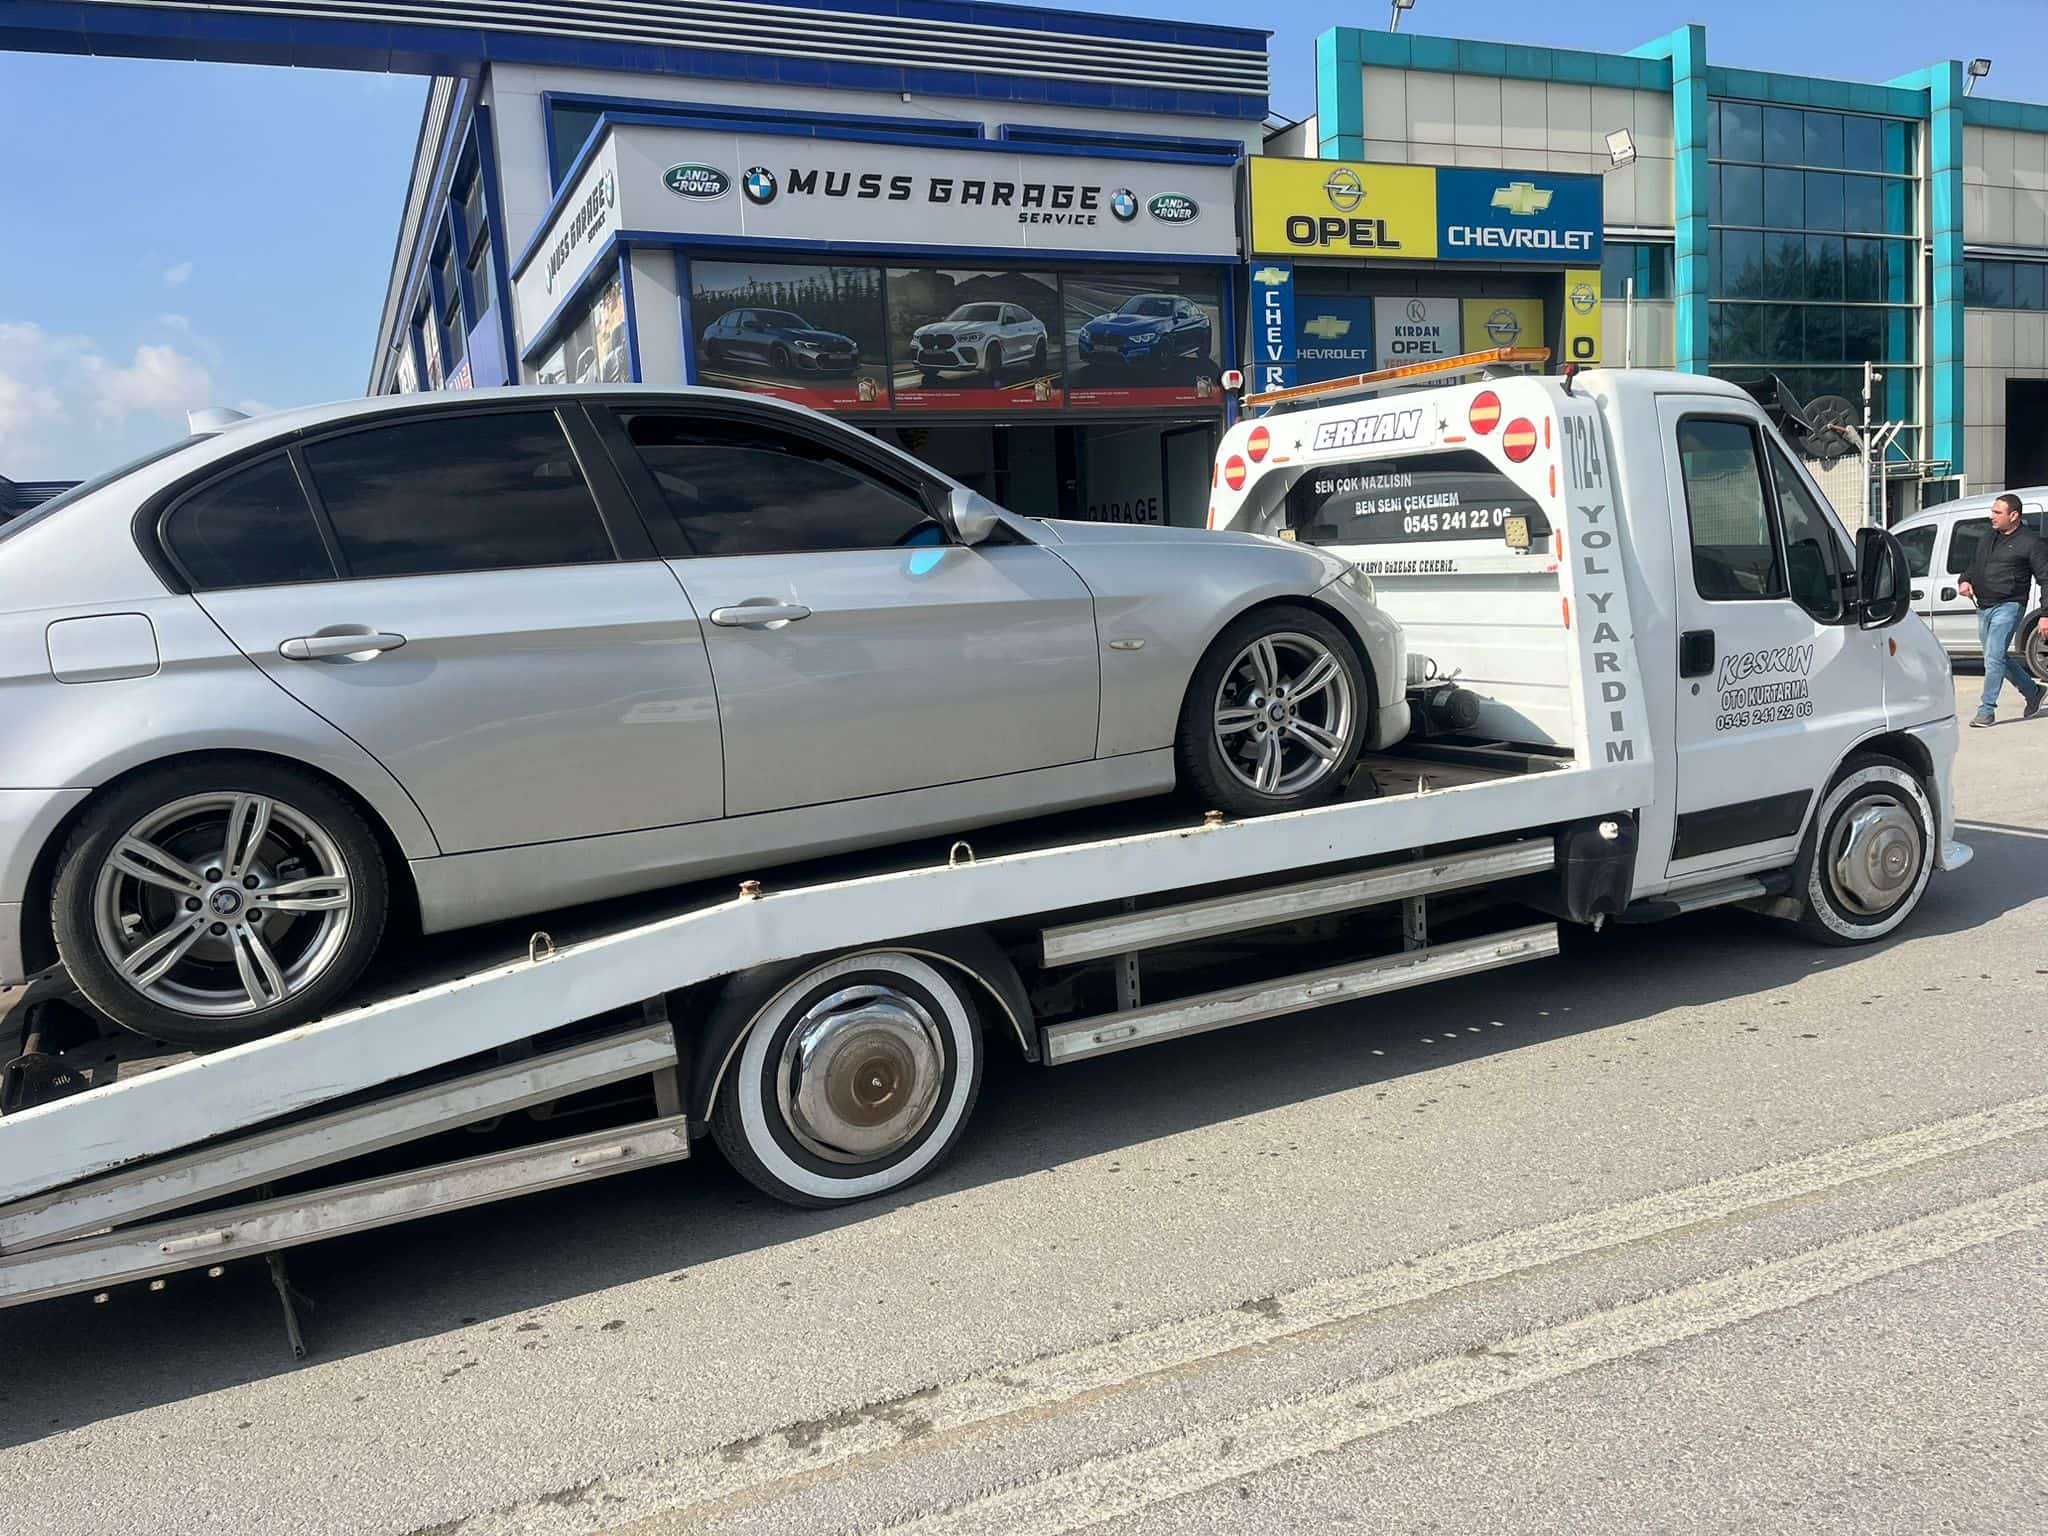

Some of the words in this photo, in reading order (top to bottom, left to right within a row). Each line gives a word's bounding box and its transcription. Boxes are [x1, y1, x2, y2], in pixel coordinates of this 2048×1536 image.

[676, 170, 710, 181] LAND
[680, 180, 720, 193] ROVER
[787, 168, 912, 201] MUSS
[928, 178, 1102, 210] GARAGE
[569, 177, 605, 250] GARAGE
[1157, 198, 1183, 209] LAND
[1160, 208, 1192, 219] ROVER
[1018, 212, 1096, 226] SERVICE
[1286, 215, 1401, 250] OPEL
[1448, 226, 1594, 250] CHEVROLET
[1395, 326, 1440, 338] KIRDAN
[1297, 348, 1367, 360] HEVROLET
[1392, 341, 1443, 354] OPEL
[1313, 408, 1423, 451] ERHAN
[1315, 479, 1334, 495] SEN
[1336, 477, 1359, 495] ÇOK
[1361, 474, 1412, 491] NAZLISIN
[1355, 500, 1376, 515] BEN
[1404, 492, 1460, 514] ÇEKEMEM
[1404, 513, 1439, 534] 0545
[1442, 511, 1467, 531] 241
[1470, 509, 1489, 529] 22
[1577, 504, 1612, 575] YOL
[1586, 592, 1635, 763] YARDIM
[1721, 688, 1746, 711] OTO
[1747, 679, 1808, 706] KURTARMA
[1716, 712, 1750, 731] 0545
[1752, 707, 1776, 725] 241
[1777, 704, 1794, 721] 22
[1796, 701, 1814, 718] 06
